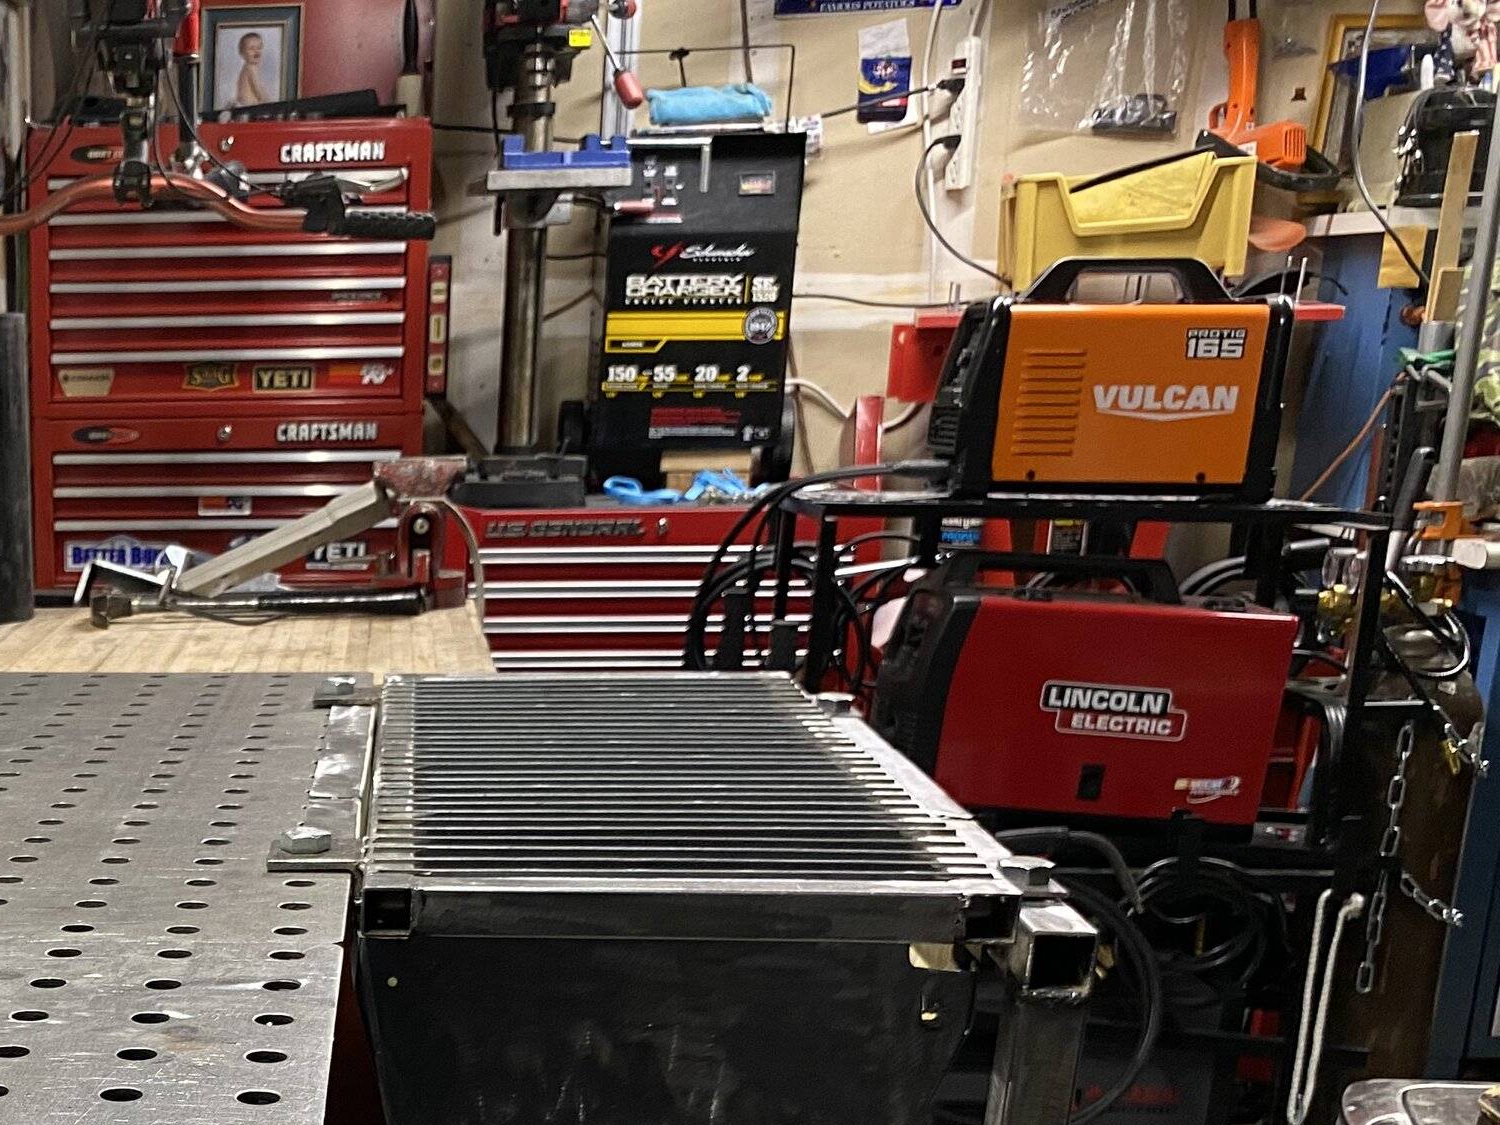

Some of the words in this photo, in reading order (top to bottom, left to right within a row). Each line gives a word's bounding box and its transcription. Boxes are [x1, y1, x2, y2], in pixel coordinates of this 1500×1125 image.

[280, 141, 386, 163] CRAFTSMAN
[626, 275, 744, 288] BATTERY
[626, 286, 743, 297] CHARGER
[1187, 338, 1243, 358] 165
[258, 369, 311, 388] YETI
[607, 365, 637, 382] 150
[653, 365, 676, 382] 55
[694, 365, 718, 382] 20
[736, 365, 750, 382] 2
[1093, 384, 1239, 410] VULCAN
[276, 423, 378, 442] CRAFTSMAN
[1048, 686, 1164, 715] LINCOLN
[1070, 712, 1173, 736] ELECTRIC
